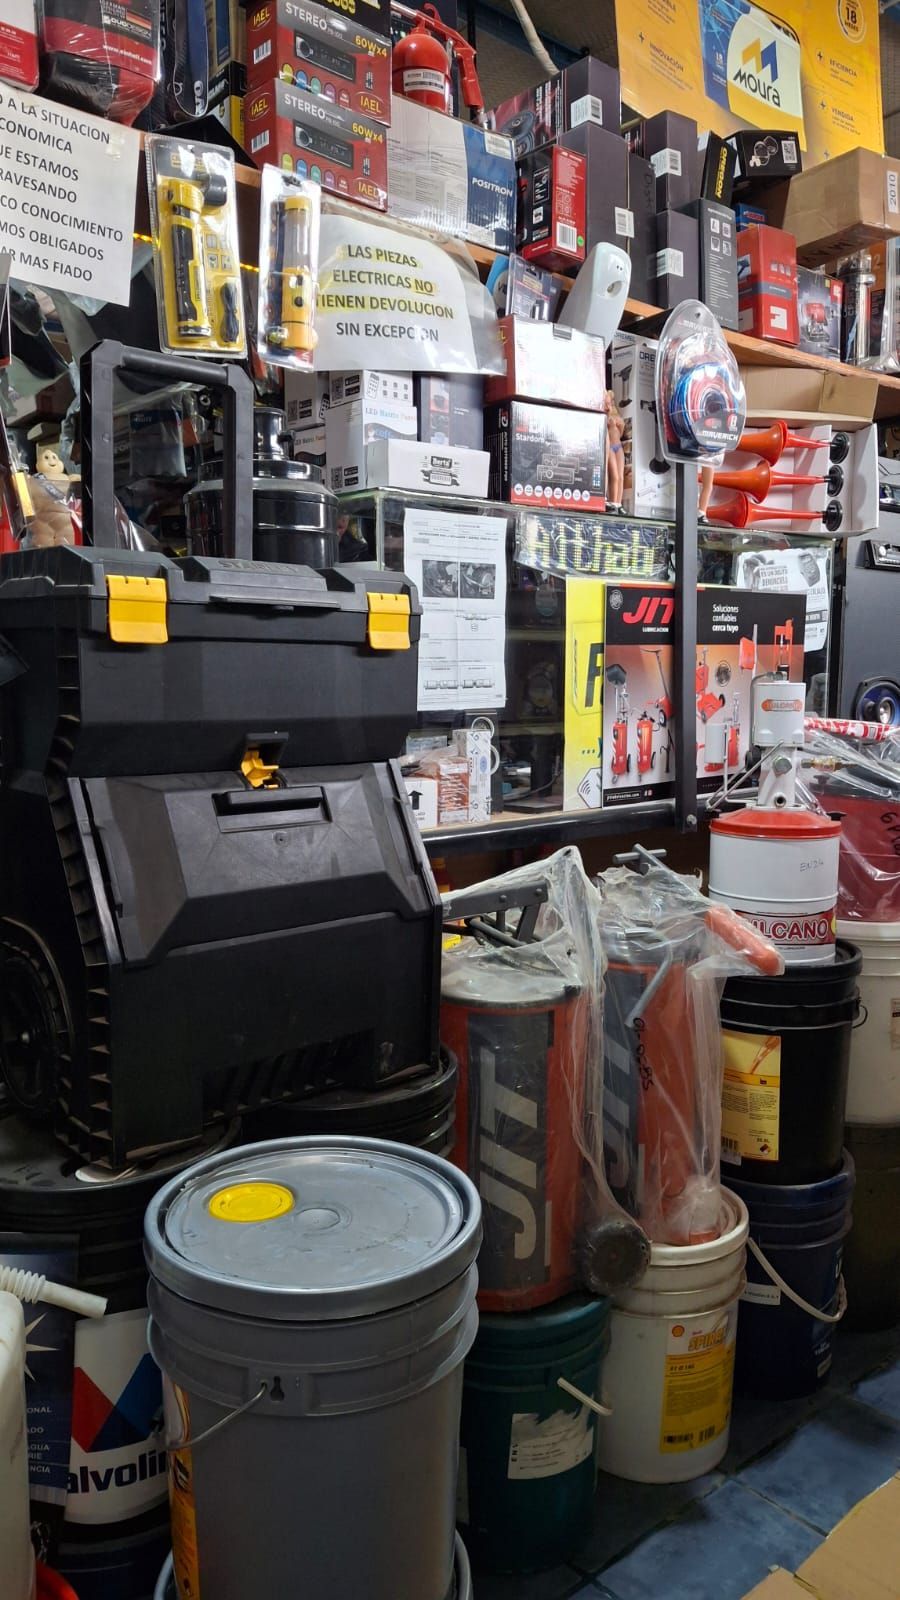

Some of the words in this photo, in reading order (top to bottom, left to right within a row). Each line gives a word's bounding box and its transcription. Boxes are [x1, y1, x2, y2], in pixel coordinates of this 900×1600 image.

[253, 9, 271, 26] IAEL
[284, 2, 328, 31] STEREO
[845, 6, 858, 25] 18
[355, 34, 388, 57] 60Wx4
[250, 99, 269, 117] IAEL
[283, 92, 326, 120] STEREO
[359, 95, 382, 114] IAEL
[7, 97, 17, 111] A
[21, 101, 38, 118] LA
[41, 108, 110, 145] SITUACION
[352, 121, 384, 145] 60Wx4
[16, 149, 79, 182] ESTAMOS
[715, 146, 728, 199] OREGON
[471, 176, 514, 198] POSITRON
[888, 174, 897, 207] 2010
[21, 202, 123, 242] CONOCIMIENTO
[29, 229, 105, 261] OBLIGADOS
[347, 244, 373, 259] LAS
[375, 248, 418, 268] PIEZAS
[20, 251, 49, 271] MAS
[53, 261, 93, 282] FIADO
[333, 269, 412, 289] ELECTRICAS
[414, 278, 434, 294] NO
[369, 296, 454, 320] DEVOLUCION
[336, 322, 361, 337] SIN
[364, 323, 440, 342] EXCEPCON
[701, 430, 739, 441] MAVERICK
[712, 603, 739, 613] Soluciones
[712, 613, 737, 623] confiables
[712, 624, 726, 632] cerca
[726, 624, 739, 634] tuyo
[752, 919, 829, 940] LCANO
[478, 1047, 539, 1261] JIT
